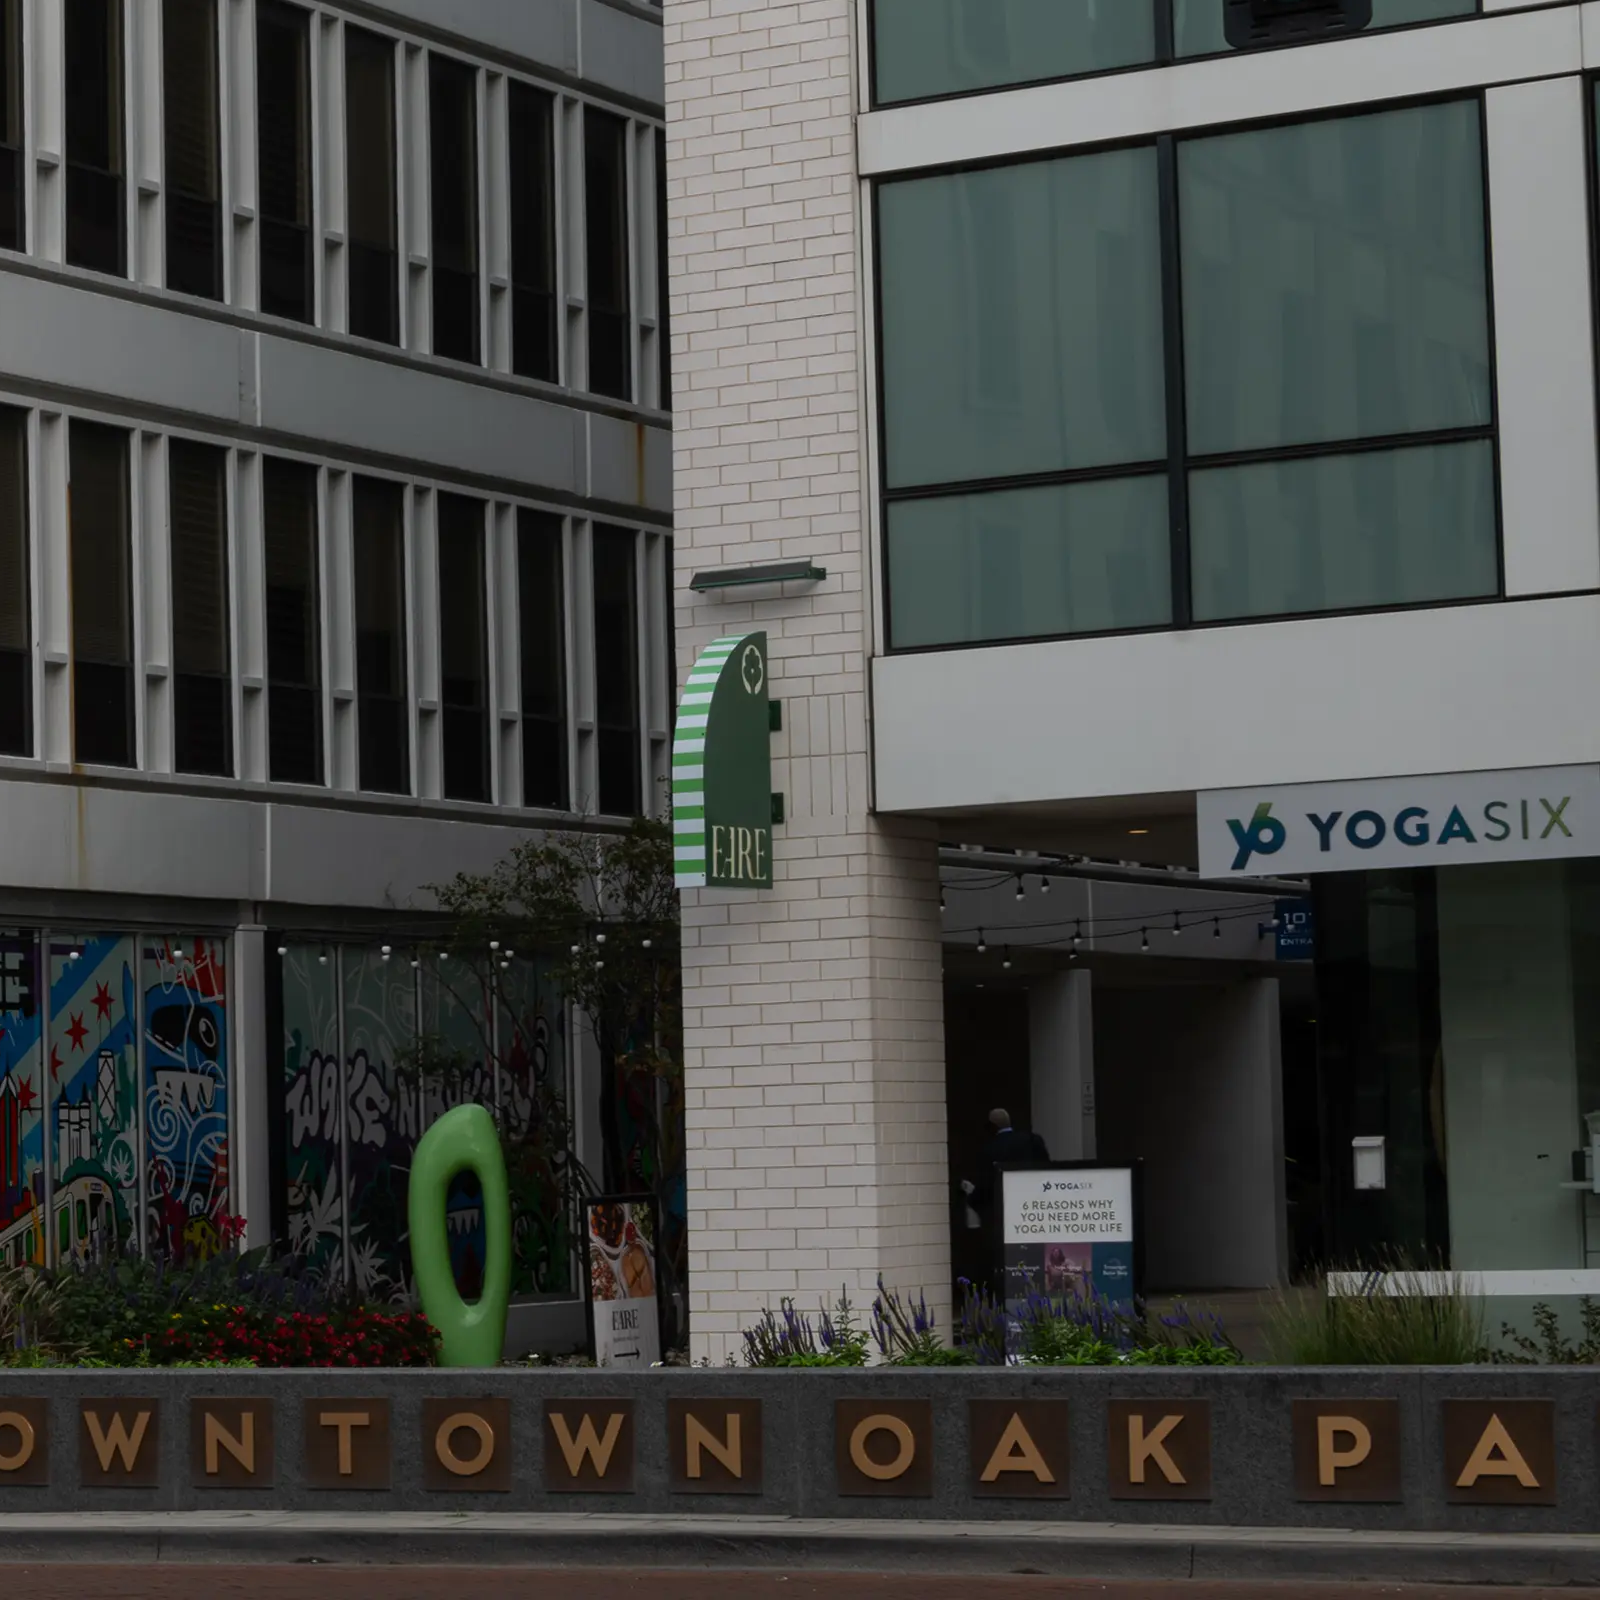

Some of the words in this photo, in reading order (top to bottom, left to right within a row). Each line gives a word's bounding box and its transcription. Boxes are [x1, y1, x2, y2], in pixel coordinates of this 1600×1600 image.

[1306, 796, 1574, 852] YOGASIX
[711, 825, 767, 880] FARE
[285, 1050, 391, 1149] WAKE
[1054, 1182, 1094, 1191] YOGASIX
[1022, 1200, 1029, 1210] 6
[1032, 1199, 1085, 1210] REASONS
[1088, 1199, 1114, 1209] WHY
[1014, 1224, 1046, 1234] YOGA
[1049, 1223, 1061, 1234] IN
[1064, 1223, 1096, 1233] YOUR
[1100, 1222, 1123, 1233] LIFE
[1020, 1212, 1045, 1222] YOU
[1048, 1211, 1079, 1222] NEED
[1082, 1211, 1116, 1221] MORE
[612, 1308, 640, 1331] FARE
[848, 1412, 1189, 1484] OAK
[1317, 1413, 1541, 1488] PA
